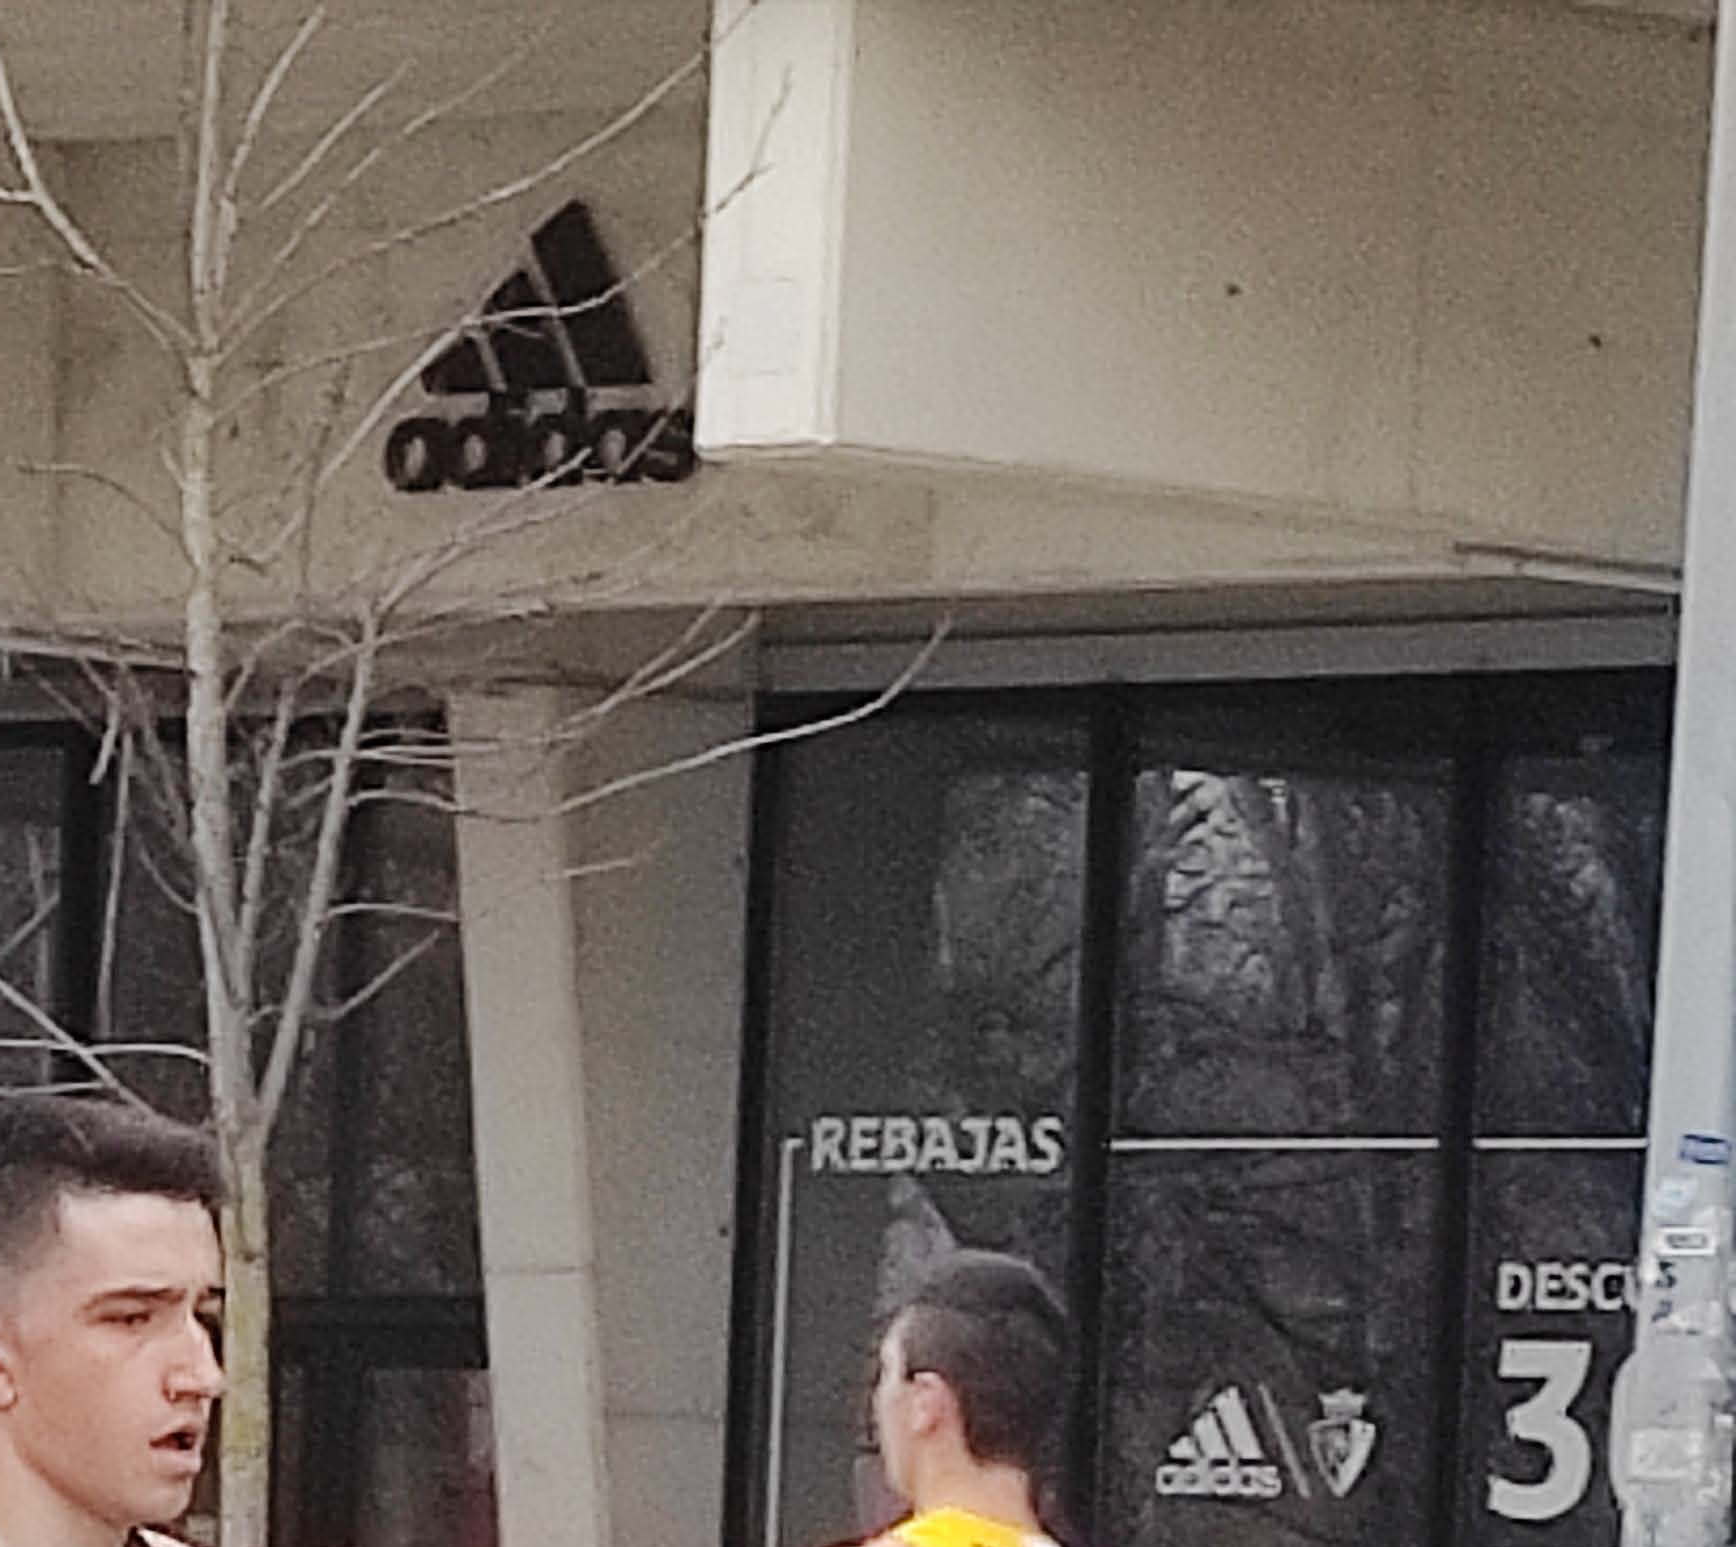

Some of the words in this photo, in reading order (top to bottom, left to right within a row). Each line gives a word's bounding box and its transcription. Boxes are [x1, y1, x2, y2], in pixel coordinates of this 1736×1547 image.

[385, 376, 698, 493] adidas
[811, 1115, 1063, 1173] REBAJAS
[1487, 1339, 1626, 1522] 3
[1156, 1458, 1282, 1498] adidas
